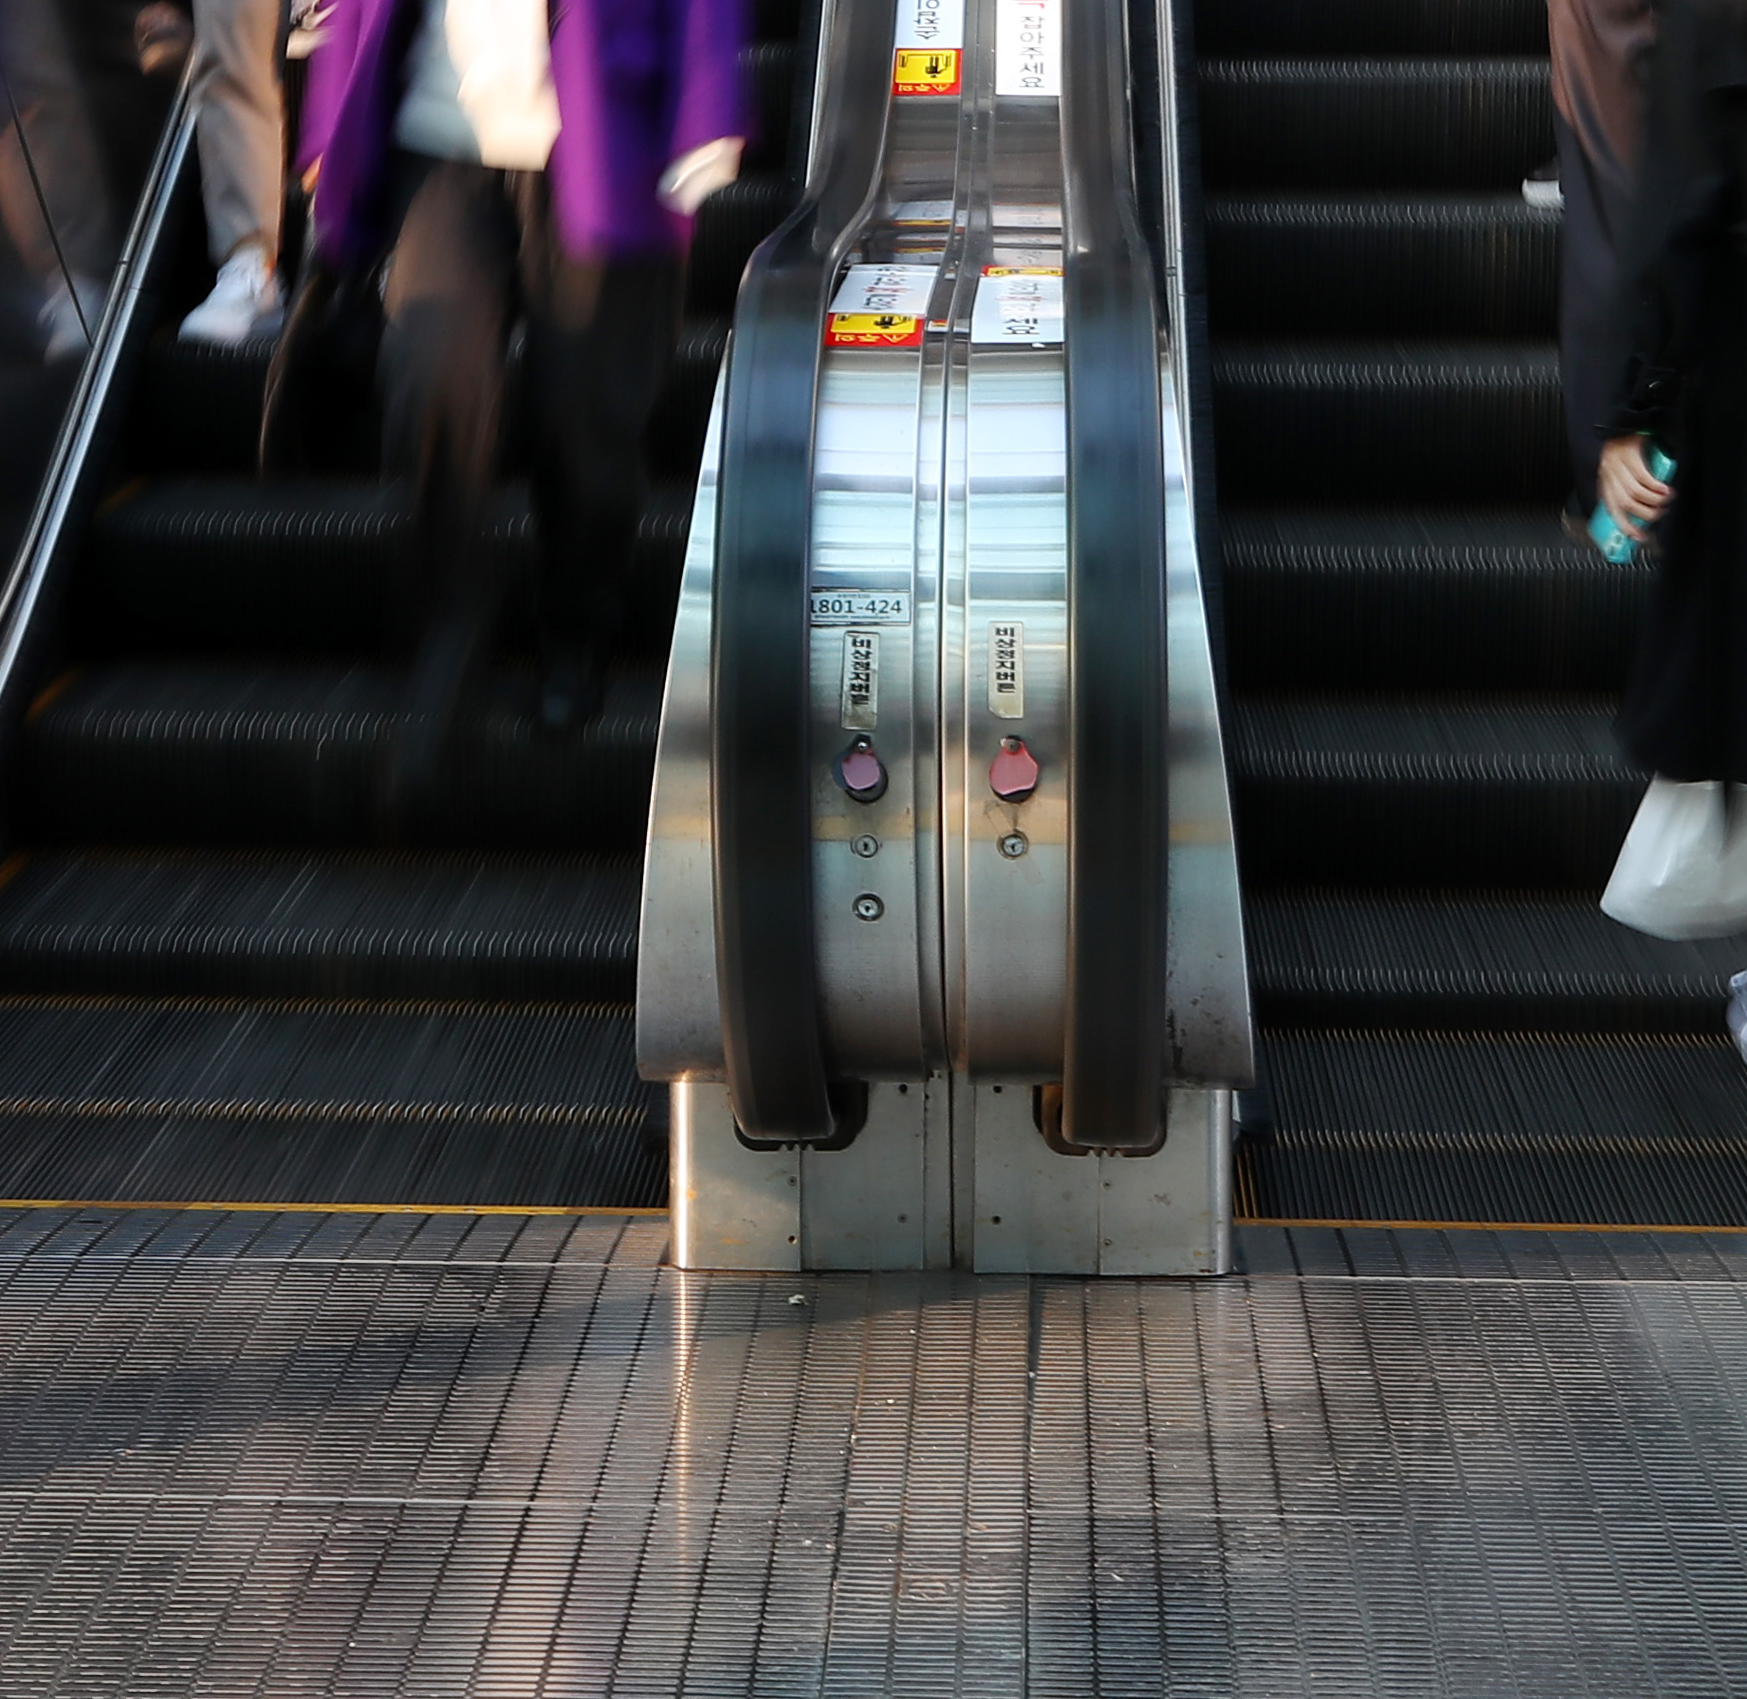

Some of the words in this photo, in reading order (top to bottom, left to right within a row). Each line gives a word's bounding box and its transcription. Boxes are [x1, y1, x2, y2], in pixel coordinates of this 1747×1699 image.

[1019, 17, 1046, 89] 잡아주세요
[849, 638, 872, 706] 비상정지버튼
[996, 626, 1016, 694] 비상정지버튼
